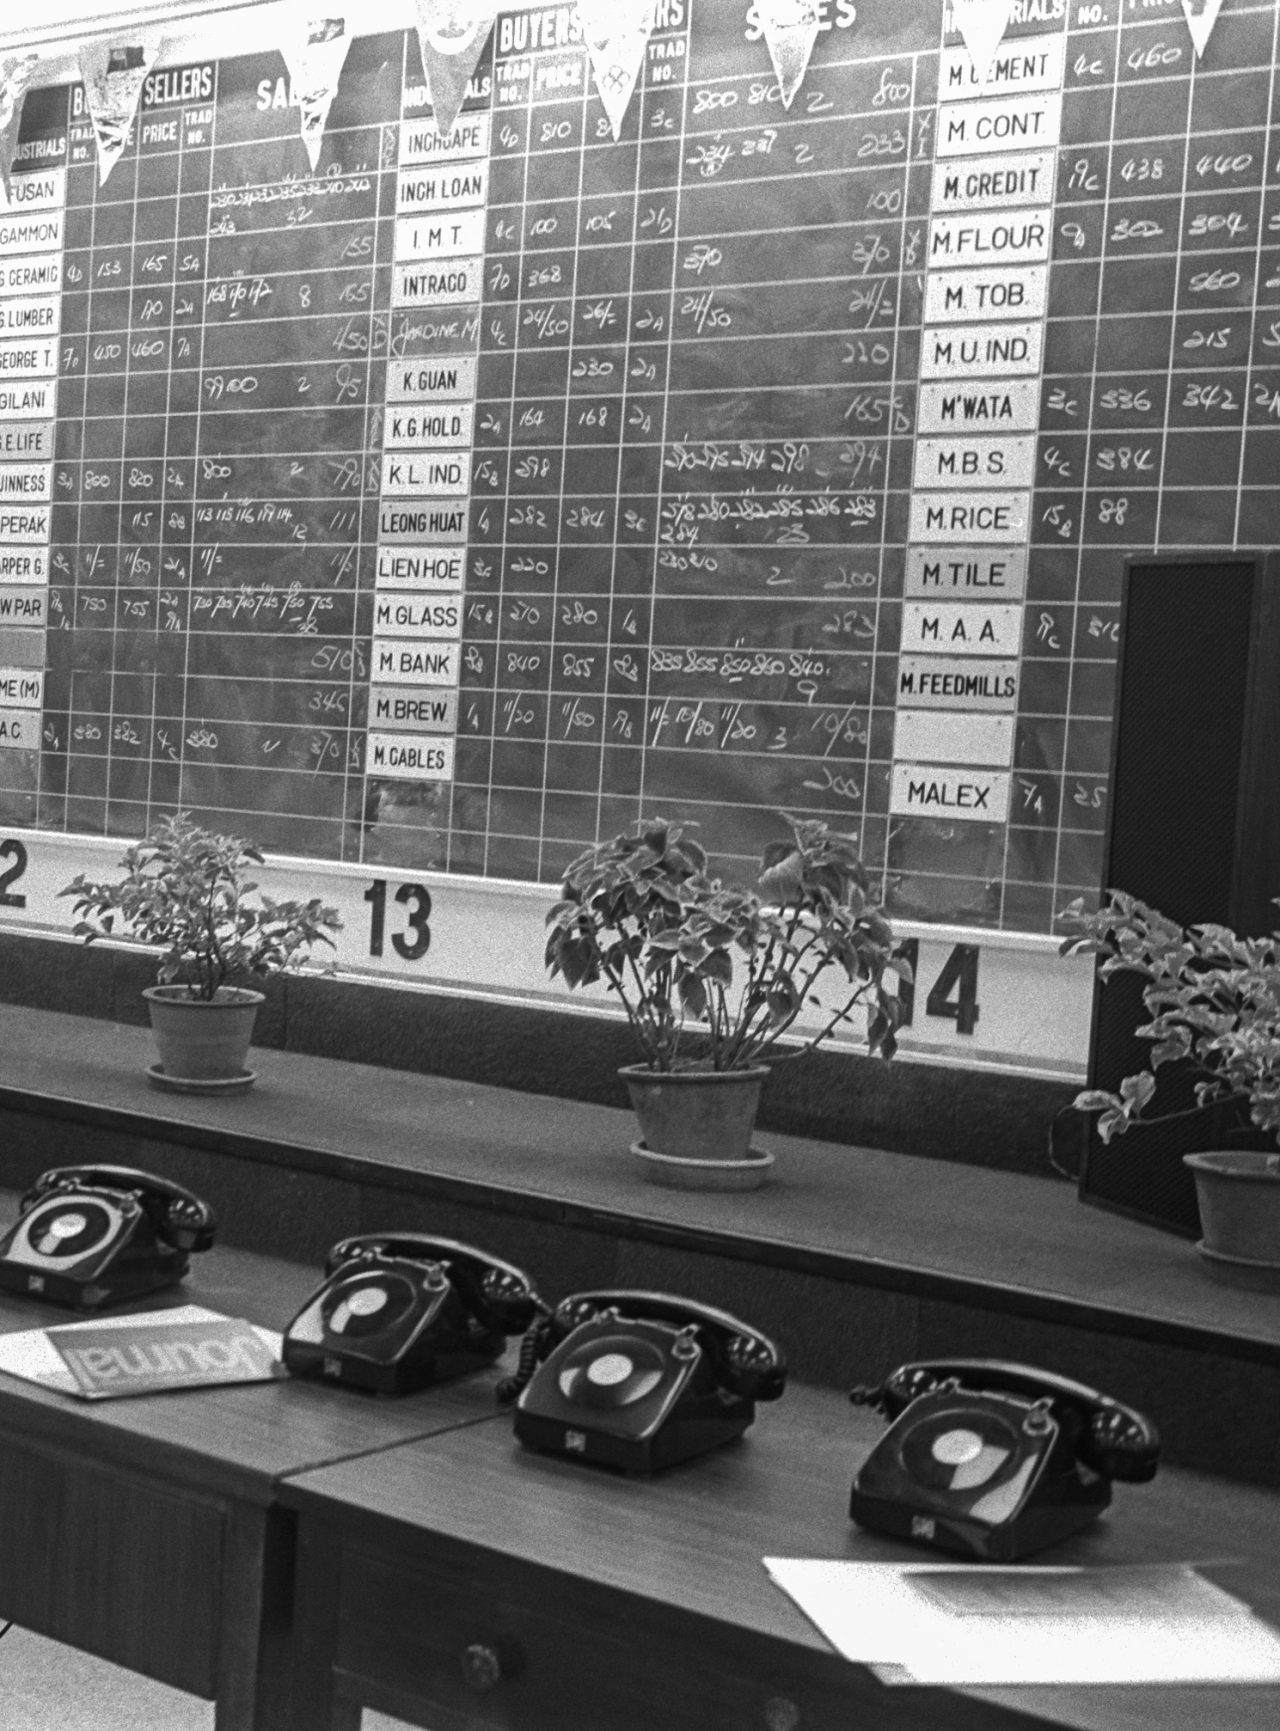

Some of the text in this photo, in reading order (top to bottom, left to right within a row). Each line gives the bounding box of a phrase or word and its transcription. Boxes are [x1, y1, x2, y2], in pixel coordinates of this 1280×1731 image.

[1077, 5, 1108, 24] NO.
[649, 42, 685, 60] TRAD
[949, 53, 1048, 87] M.MENT
[144, 67, 212, 105] SELLERS
[256, 76, 302, 111] SAL
[185, 109, 212, 126] TRAD
[143, 121, 178, 145] PRICE
[401, 176, 482, 203] INCH LOAN
[0, 223, 59, 245] GAMMON
[933, 224, 1044, 255] M.FLOUR
[381, 511, 465, 533] LEONG HUAT
[926, 506, 1011, 530] M.RICE
[379, 558, 461, 579] LIEN HOE
[922, 562, 1007, 588] M.TILE
[14, 599, 42, 616] PAR
[377, 607, 458, 626] M.GLASS
[900, 673, 1016, 698] M.FEEDMILLS
[374, 746, 445, 770] M.CABLES
[908, 781, 990, 808] MALEX
[363, 879, 432, 961] 13
